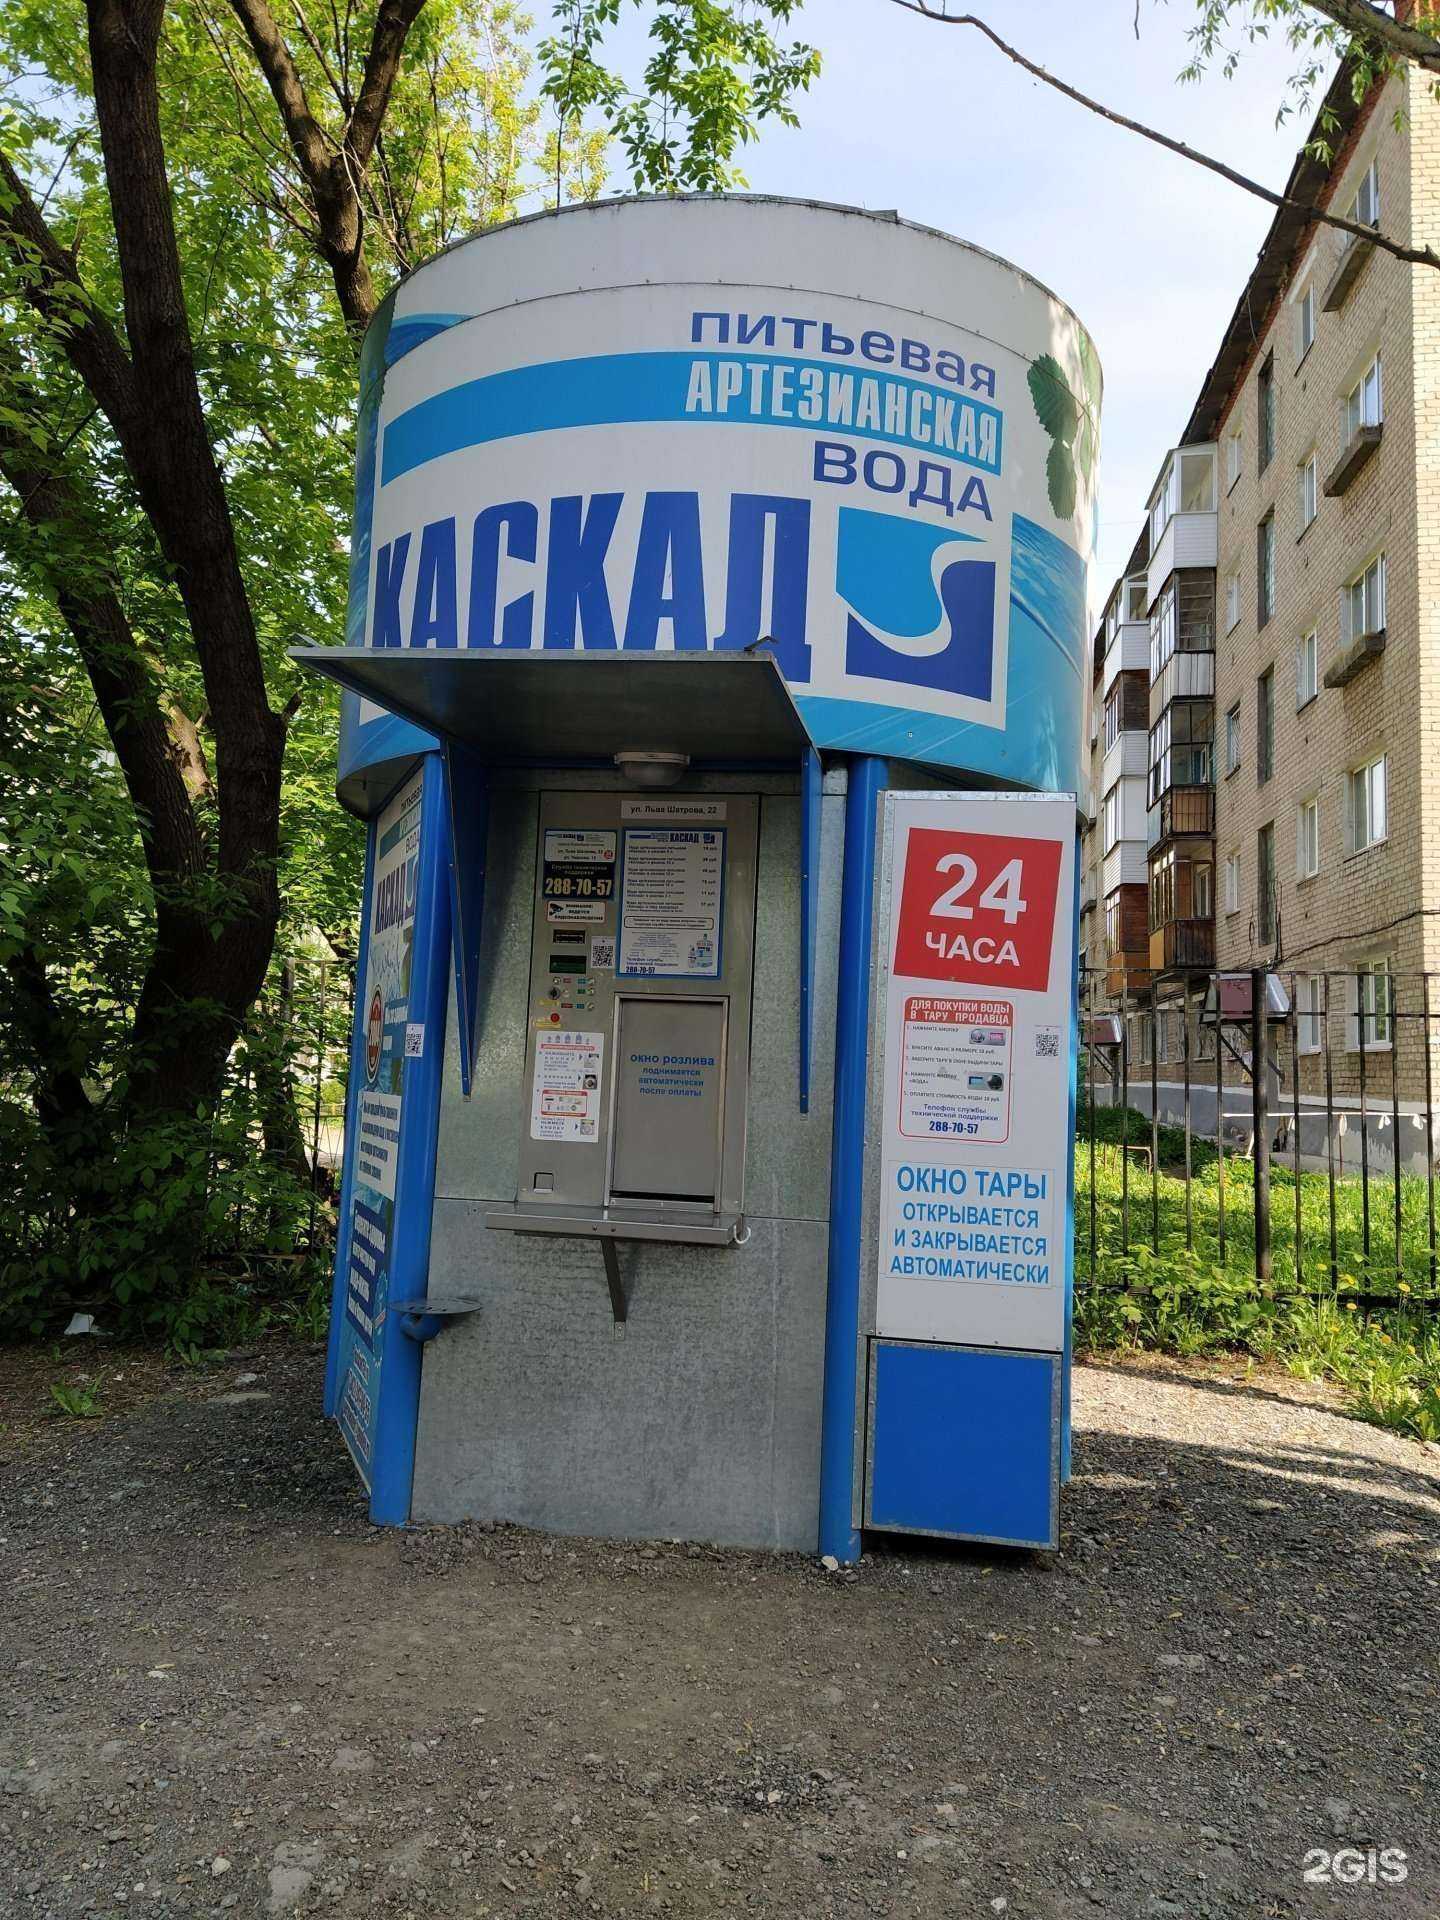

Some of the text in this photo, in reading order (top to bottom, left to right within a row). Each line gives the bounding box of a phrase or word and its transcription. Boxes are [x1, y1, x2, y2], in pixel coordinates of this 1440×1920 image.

[691, 312, 996, 399] питьевая
[685, 360, 998, 466] АРТЕЗИАНСКАЯ
[813, 440, 993, 522] ВОДА
[372, 491, 812, 684] КАСКАД
[707, 806, 717, 814] 22
[670, 833, 700, 844] КАСКАД
[375, 862, 406, 934] КАСКАД
[545, 878, 612, 896] 288-70-57
[929, 853, 1027, 925] 24
[925, 931, 1020, 967] ЧАСА
[910, 1010, 1009, 1024] В ТАРУ ПРОДАВЦА
[911, 1000, 1010, 1014] ДЛЯ ПОКУПКИ ВОДЫ
[630, 1054, 715, 1066] окно розлива
[639, 1077, 704, 1087] автоматически
[640, 1087, 702, 1097] после оплаты
[911, 1111, 999, 1122] технической поддержки
[924, 1104, 986, 1114] Телефон службы
[928, 1121, 979, 1134] 288-70-57
[897, 1165, 1046, 1199] ОКНО ТАРЫ
[903, 1202, 1039, 1229] ОТКРЫВАЕТСЯ
[894, 1228, 1047, 1256] И ЗАКРЫВАЕТСЯ
[890, 1255, 1049, 1284] АВТОМАТИЧЕСКИ
